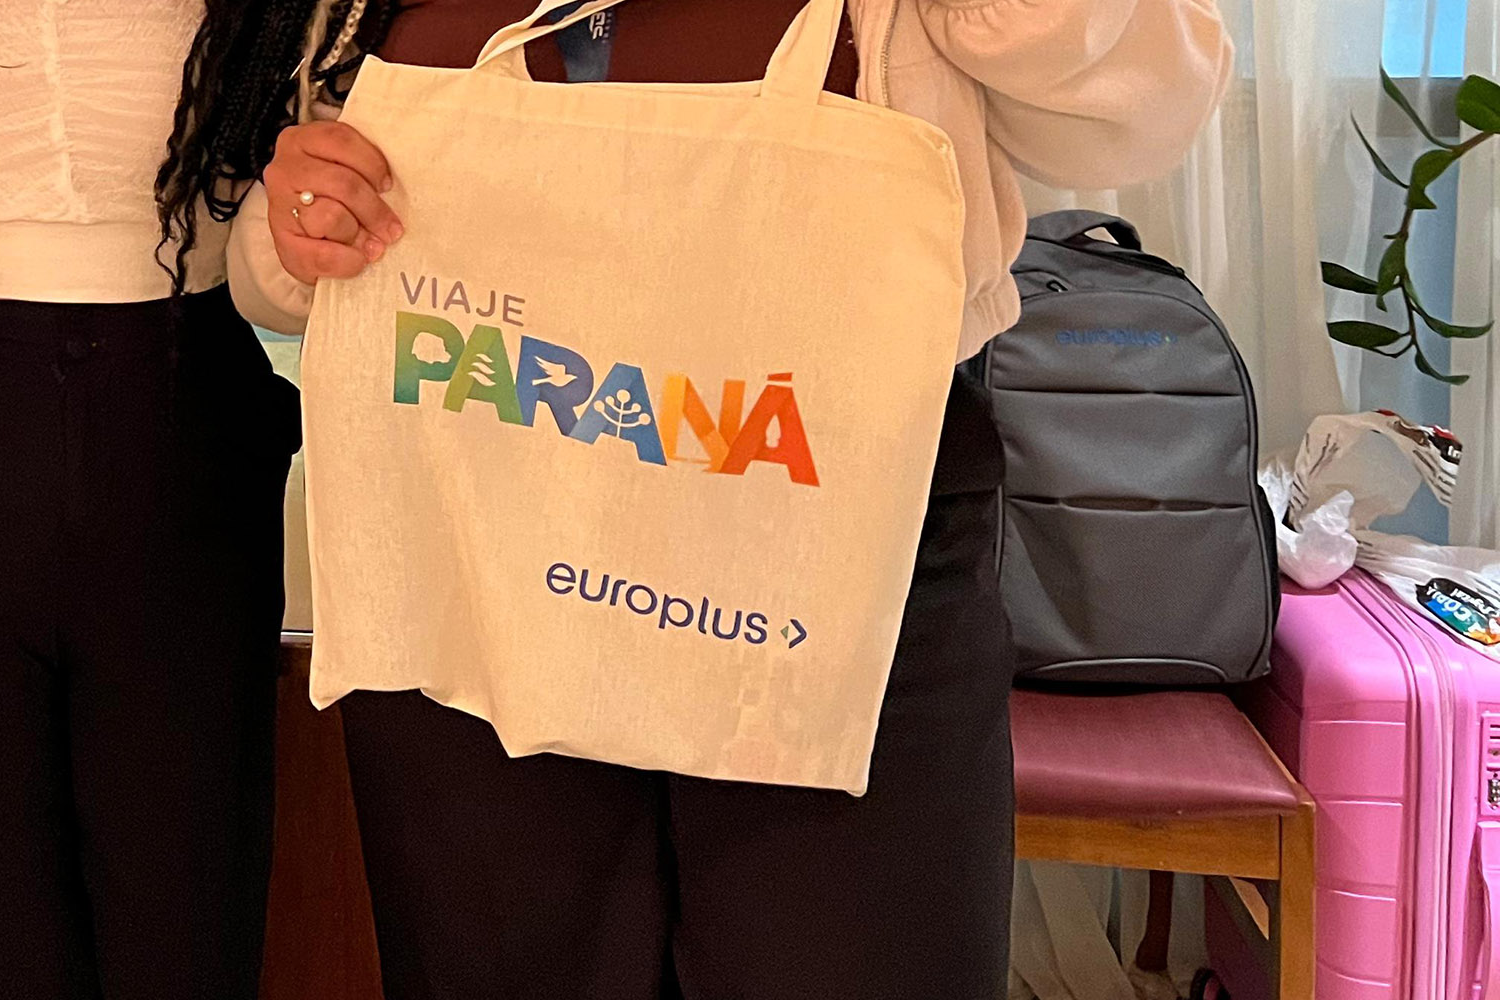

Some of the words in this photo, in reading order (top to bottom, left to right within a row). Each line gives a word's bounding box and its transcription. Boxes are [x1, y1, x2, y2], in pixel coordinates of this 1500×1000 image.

[400, 271, 526, 327] VIAJE
[393, 310, 820, 487] PARANÁ
[546, 562, 768, 645] europlus
